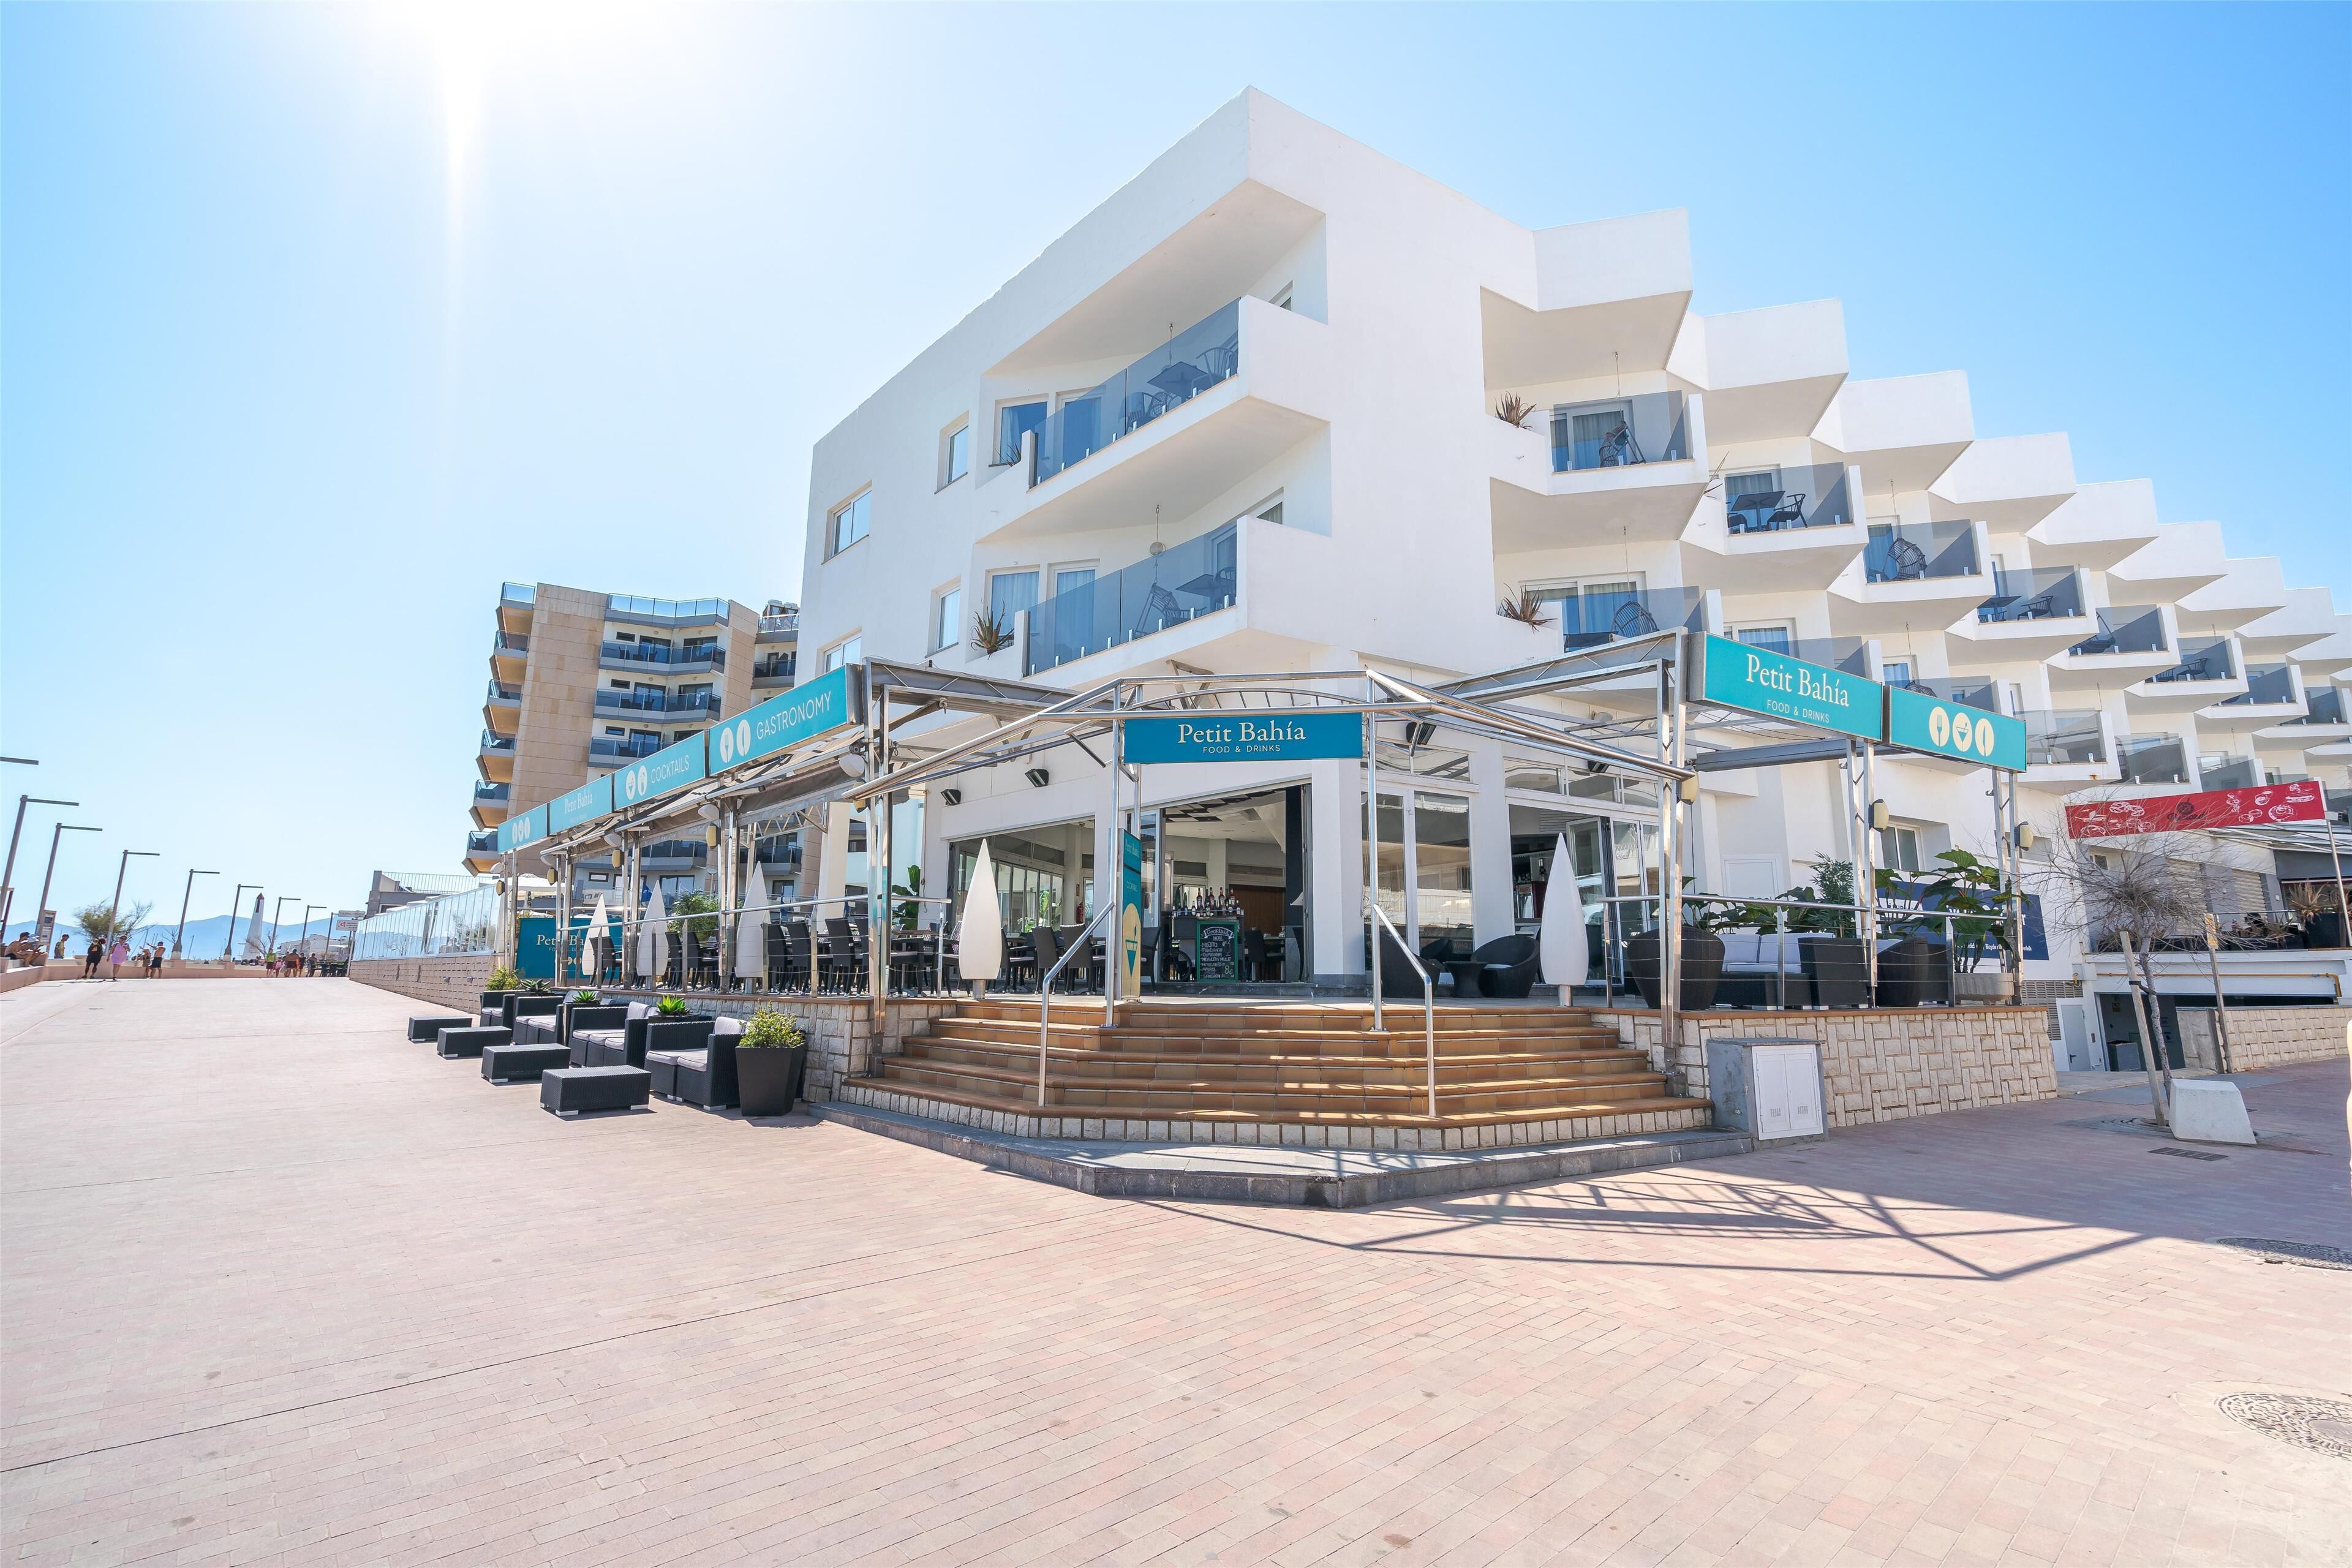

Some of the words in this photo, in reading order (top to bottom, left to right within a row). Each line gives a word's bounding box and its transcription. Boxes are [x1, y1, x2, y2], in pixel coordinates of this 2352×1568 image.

[1746, 654, 1793, 692] Petit
[1798, 668, 1850, 707] Bahía
[756, 690, 831, 739] GASTRONOMY
[1767, 699, 1790, 714] FOOD
[1793, 706, 1799, 716] &
[1803, 708, 1830, 723] DRINKS
[1177, 724, 1232, 743] Petit
[1238, 720, 1306, 742] Bahía
[1246, 744, 1281, 753] DRINKS
[651, 755, 689, 783] COCKTAILS
[537, 935, 556, 945] Pet
